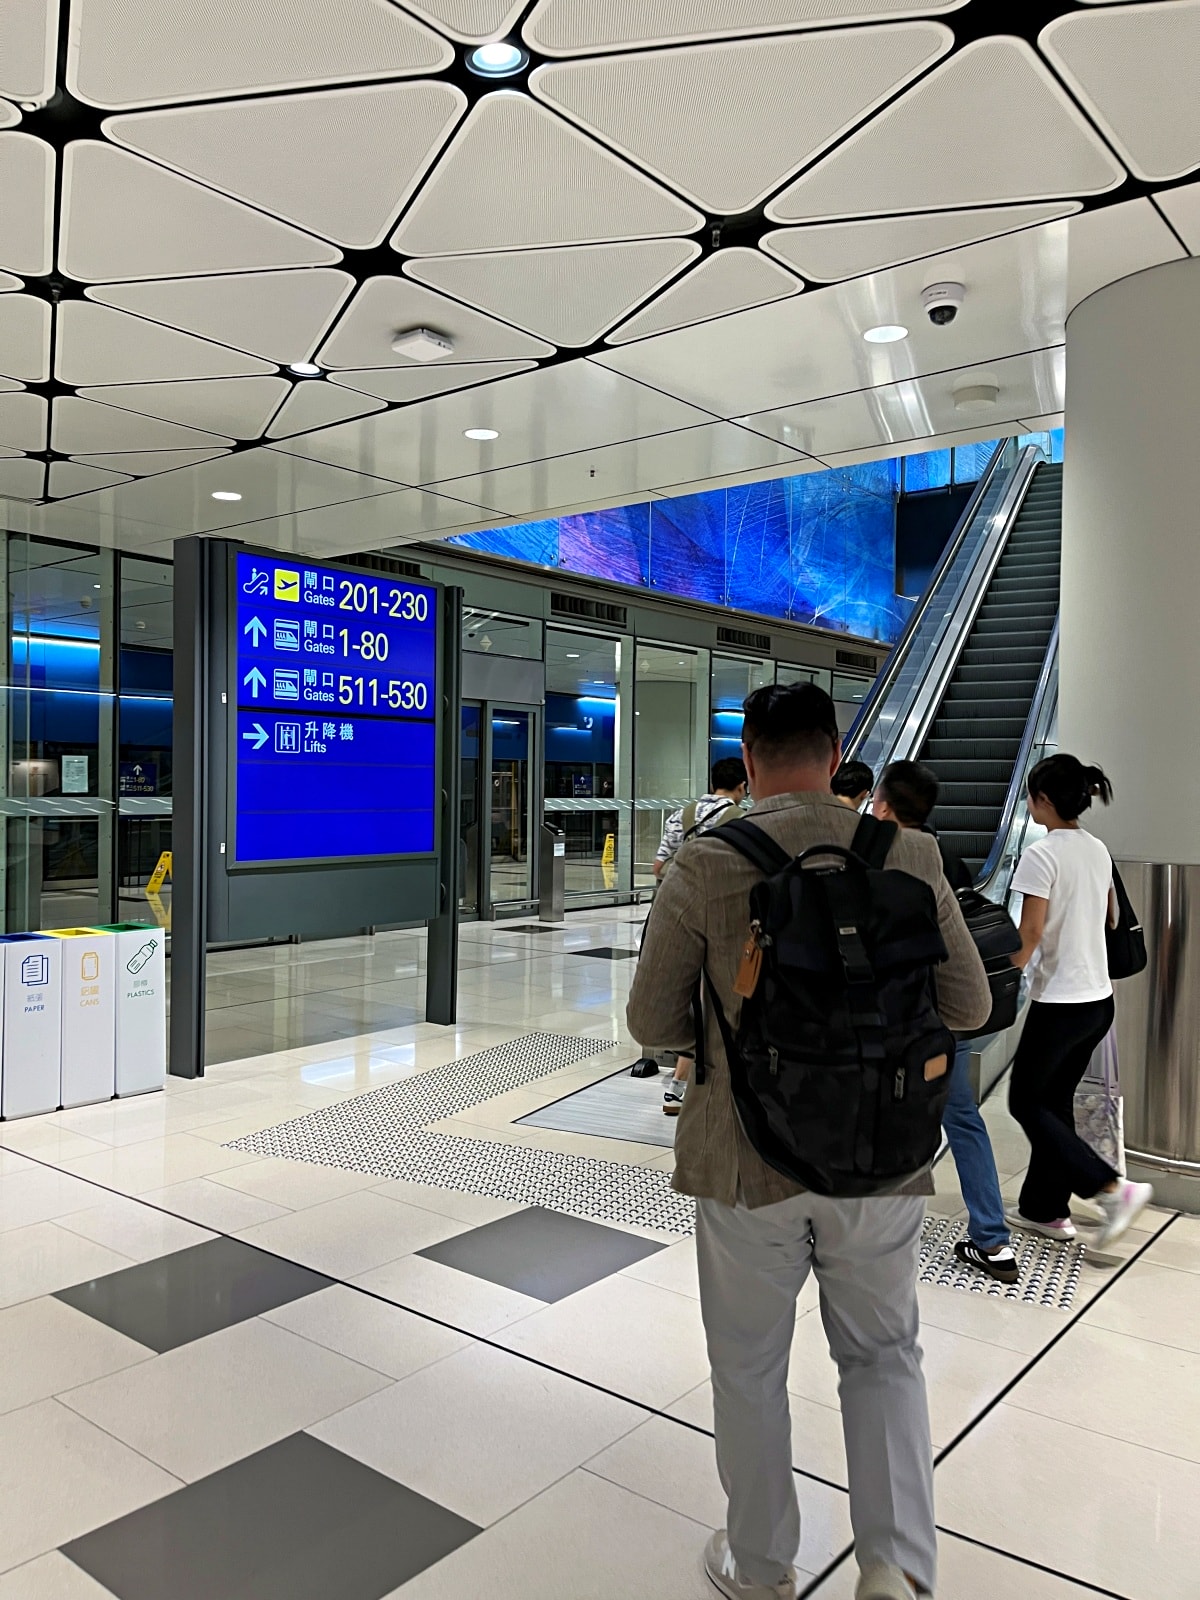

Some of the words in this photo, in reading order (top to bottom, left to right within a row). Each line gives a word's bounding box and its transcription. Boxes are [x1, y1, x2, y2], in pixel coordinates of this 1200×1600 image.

[303, 571, 335, 592] 閘口
[303, 591, 335, 606] Gates
[339, 580, 428, 622] 201-230
[303, 620, 335, 640] 閘口
[303, 640, 335, 654] Gates
[339, 628, 389, 662] 1-80
[303, 668, 334, 687] 閘口
[303, 688, 335, 702] Gates
[338, 675, 428, 710] 511-530
[304, 721, 354, 741] 升降機
[304, 741, 327, 753] Lifts
[79, 999, 100, 1007] CANS
[127, 989, 155, 998] PLASTICS
[24, 1004, 45, 1013] PAPER
